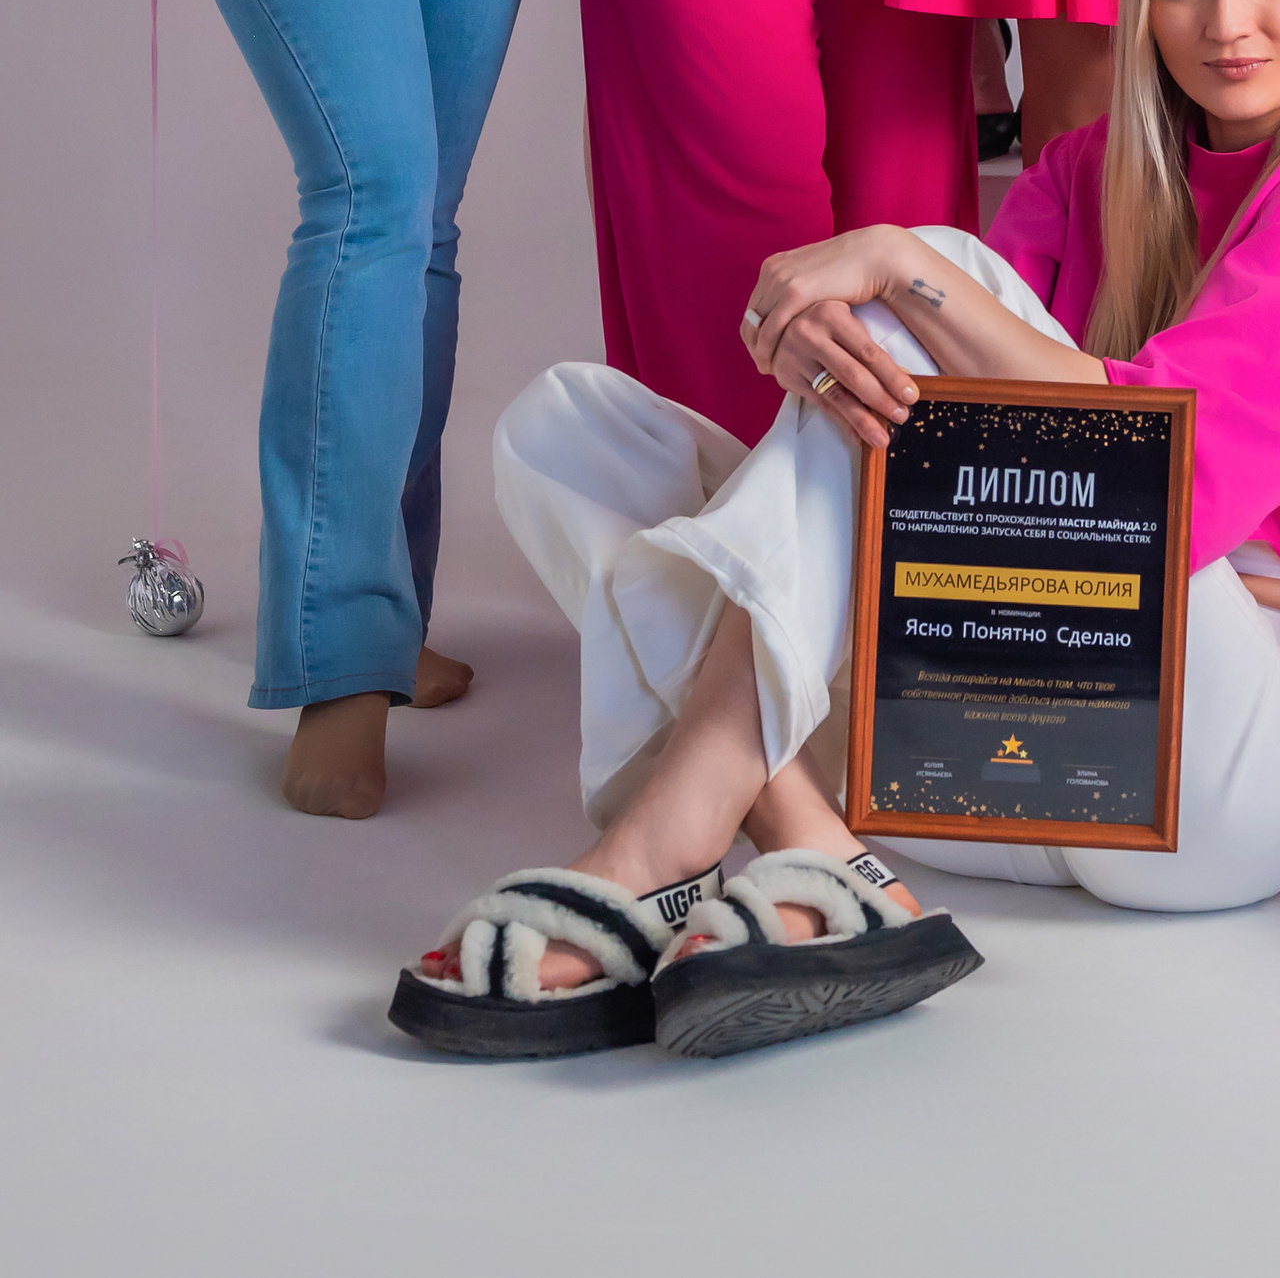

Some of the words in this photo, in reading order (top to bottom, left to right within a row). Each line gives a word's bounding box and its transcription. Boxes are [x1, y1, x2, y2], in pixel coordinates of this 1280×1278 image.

[953, 465, 1094, 507] ДИПЛОМ
[889, 508, 973, 521] СВИДЕТЕЛЬСТВУЕТ
[975, 513, 983, 522] О
[985, 514, 1056, 526] ПРОХОЖДЕНИИ
[1058, 518, 1096, 528] МАСТЕР
[1097, 519, 1140, 531] МАЙНДА
[1142, 522, 1157, 531] 2.0
[891, 521, 906, 530] ПО
[907, 523, 979, 534] НАПРАВЛЕНИЮ
[981, 526, 1022, 536] ЗАПУСКА
[1023, 528, 1046, 538] СЕБЯ
[1048, 530, 1054, 538] В
[1056, 530, 1121, 542] СОЦИАЛЬНЫХ
[1123, 534, 1150, 543] СЕТЯХ
[905, 570, 1069, 594] МУХАМЕДЬЯРОВА
[1075, 580, 1132, 597] ЮЛИЯ
[905, 618, 952, 637] Ясно
[962, 621, 1046, 642] Понятно
[1056, 626, 1131, 648] Сделаю
[852, 860, 886, 884] GG
[656, 884, 703, 923] UGG
